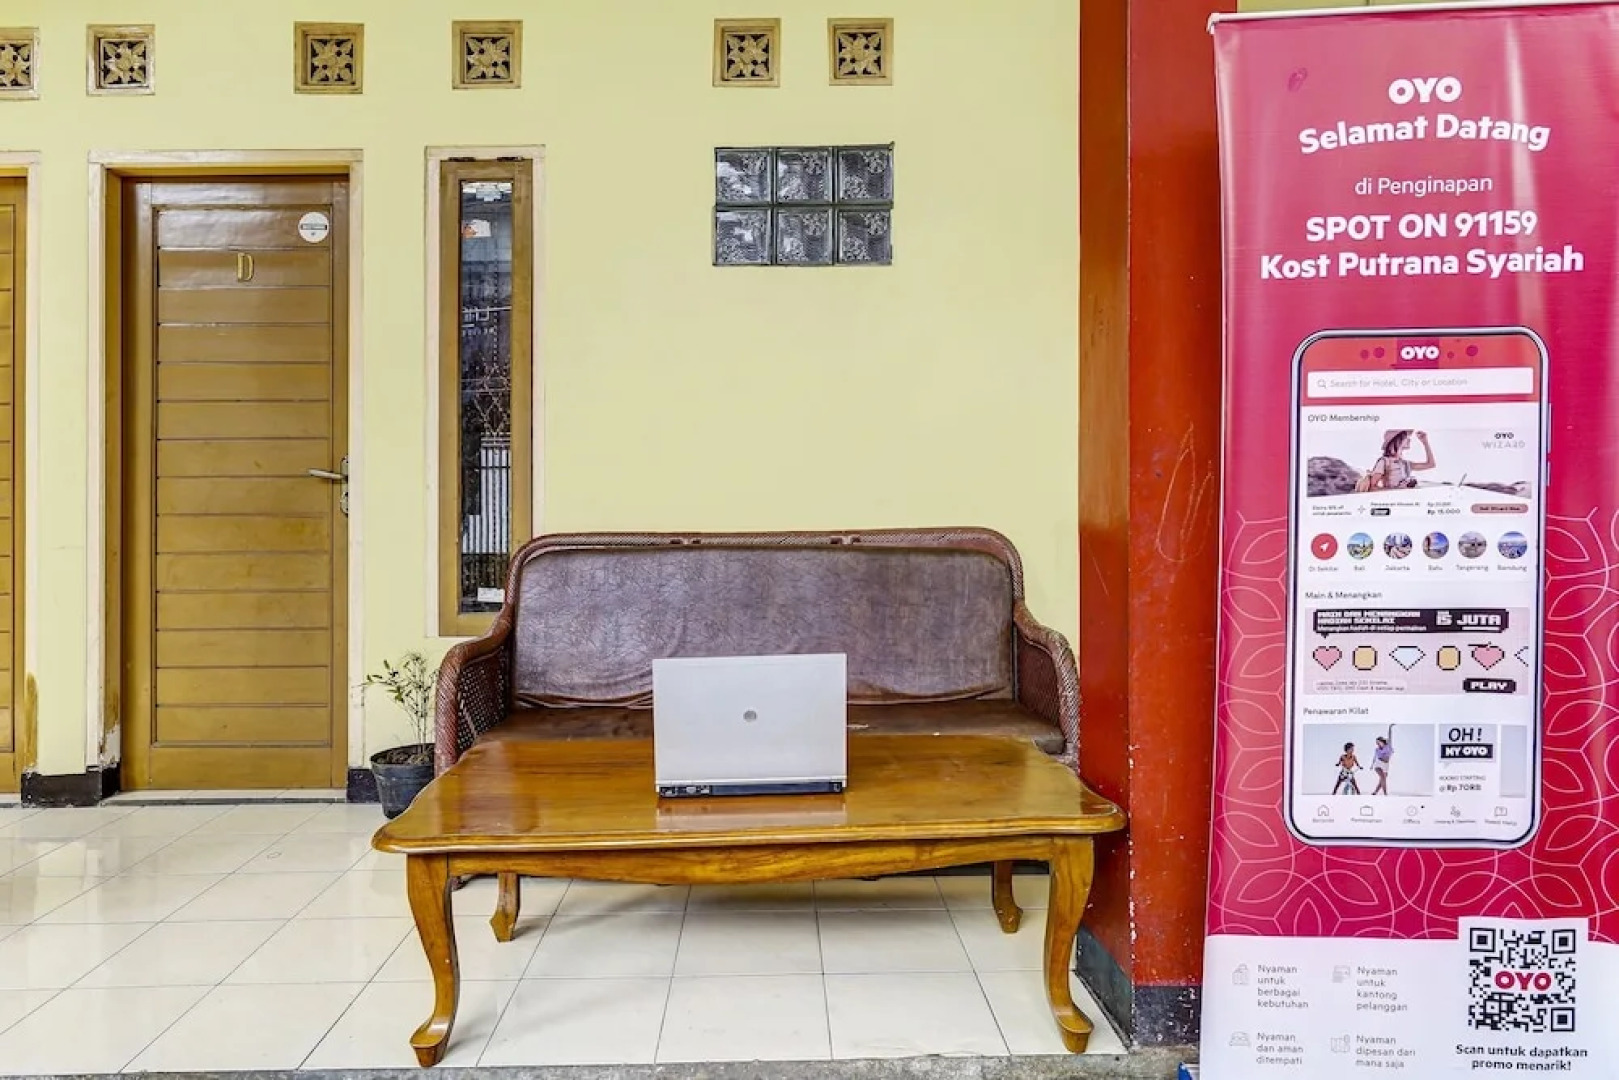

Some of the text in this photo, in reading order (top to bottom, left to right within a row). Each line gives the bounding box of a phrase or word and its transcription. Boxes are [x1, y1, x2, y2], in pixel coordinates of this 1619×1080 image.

[1388, 76, 1462, 104] OYO
[1299, 114, 1551, 153] Selamat Datang
[1355, 175, 1493, 197] di Penginapan
[1306, 210, 1538, 242] SPOT ON 91159
[237, 251, 254, 282] D
[1260, 245, 1585, 280] Kost Putrana Syariah
[1400, 345, 1440, 361] OYO
[1330, 379, 1357, 388] Search
[1359, 379, 1371, 388] for
[1401, 378, 1419, 389] City
[1421, 378, 1431, 387] or
[1432, 377, 1468, 387] Location
[1307, 413, 1380, 424] OYO Membership
[1494, 431, 1515, 440] OYO
[1385, 564, 1411, 572] Jakarta
[1304, 589, 1382, 600] Main & Menangkan
[1457, 614, 1502, 626] JUTA
[1469, 681, 1508, 691] PLAY
[1303, 707, 1369, 716] Penawaran Kilat
[1462, 746, 1489, 757] OYO
[1257, 964, 1298, 975] Nyaman
[1356, 966, 1398, 977] Nyaman
[1257, 976, 1286, 985] untuk
[1356, 978, 1386, 987] untuk
[1494, 970, 1552, 992] OYO
[1257, 987, 1301, 998] berbagai
[1356, 990, 1398, 1001] kantong
[1257, 999, 1309, 1009] kebutuhan
[1356, 1002, 1408, 1013] pelanggan
[1256, 1032, 1296, 1043] Nyaman
[1356, 1035, 1397, 1045] Nyaman
[1256, 1044, 1304, 1054] dan aman
[1355, 1046, 1416, 1058] dipesan dari
[1456, 1044, 1588, 1060] Scan untuk dapatkan
[1255, 1056, 1303, 1067] ditempati
[1355, 1058, 1405, 1070] mana saja
[1471, 1059, 1572, 1072] promo menarik!
